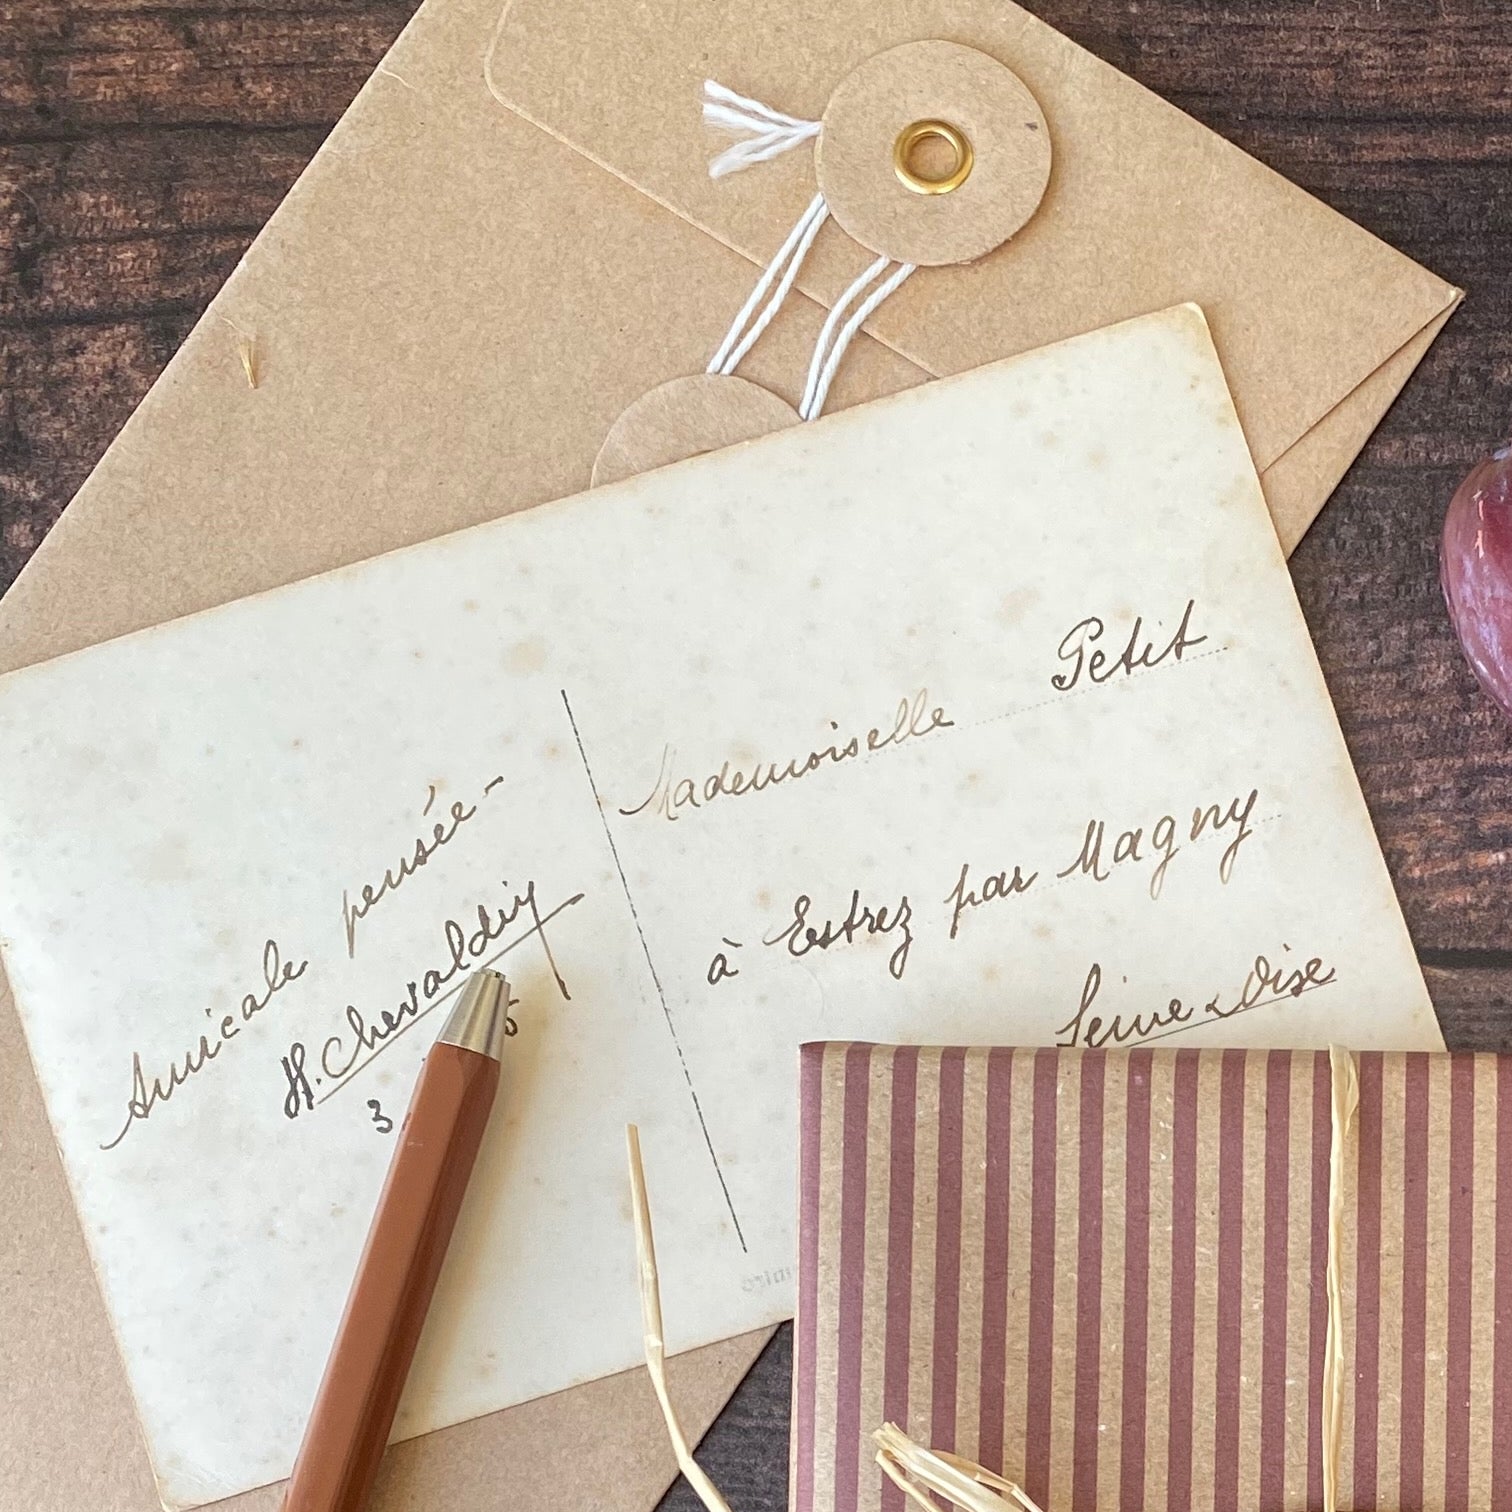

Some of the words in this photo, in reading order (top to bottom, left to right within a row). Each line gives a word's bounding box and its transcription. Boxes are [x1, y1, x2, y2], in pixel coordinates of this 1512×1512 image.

[1051, 599, 1208, 691] Petit
[707, 936, 743, 985] à
[1056, 788, 1259, 900] Magny
